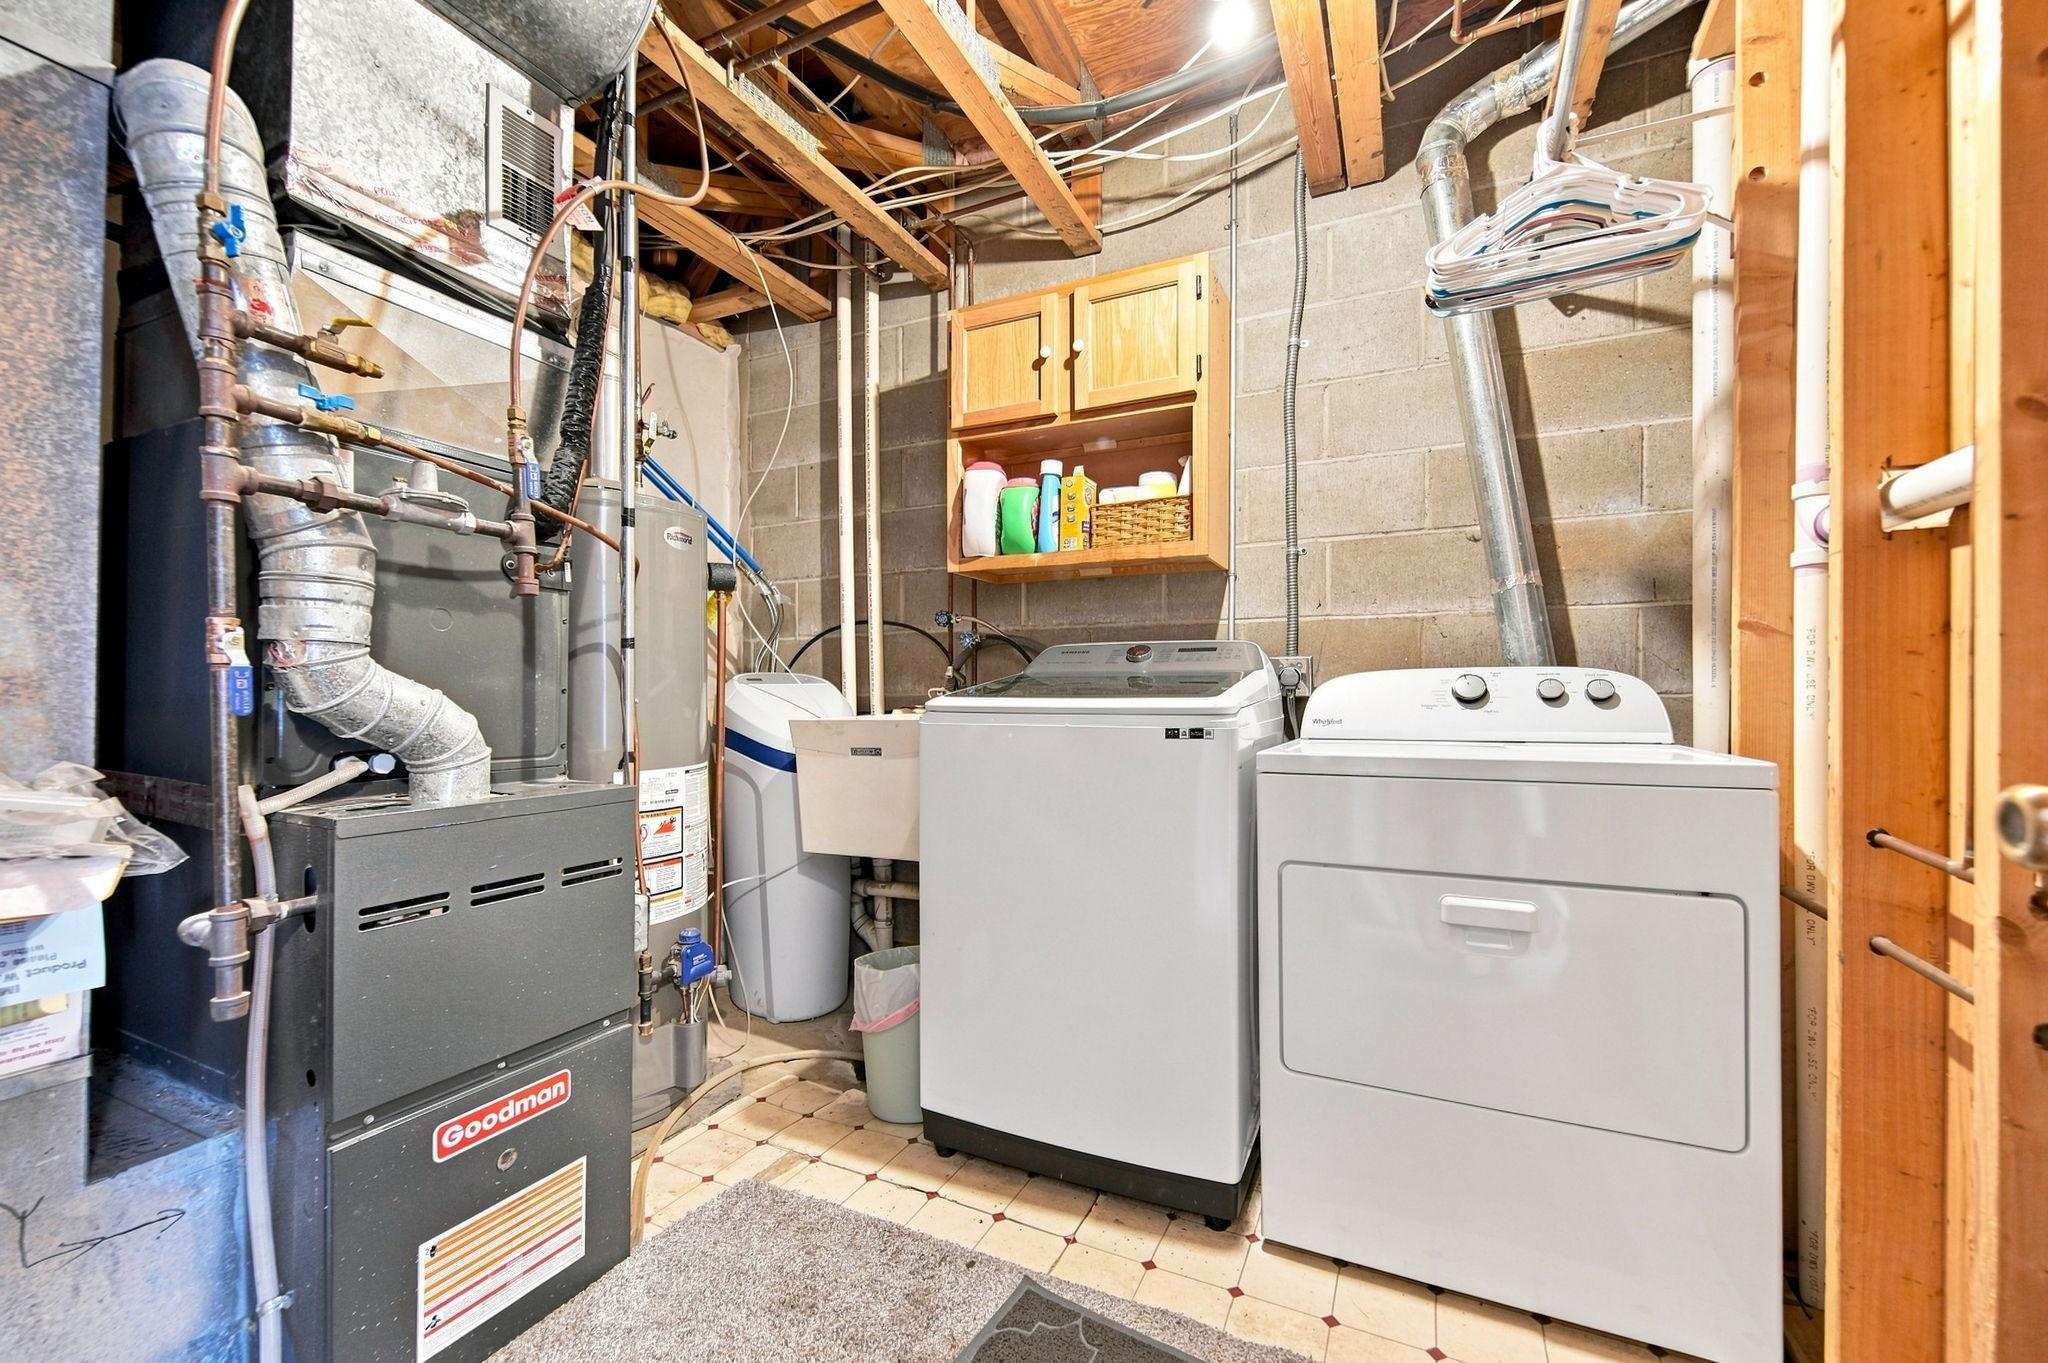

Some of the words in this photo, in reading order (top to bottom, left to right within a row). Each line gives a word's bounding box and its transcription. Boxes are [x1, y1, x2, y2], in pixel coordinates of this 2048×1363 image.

[666, 532, 693, 545] Richmond
[1312, 717, 1343, 727] Whirlpool
[1807, 874, 1816, 894] DWV
[25, 959, 87, 978] Product
[441, 1081, 566, 1148] Goodman
